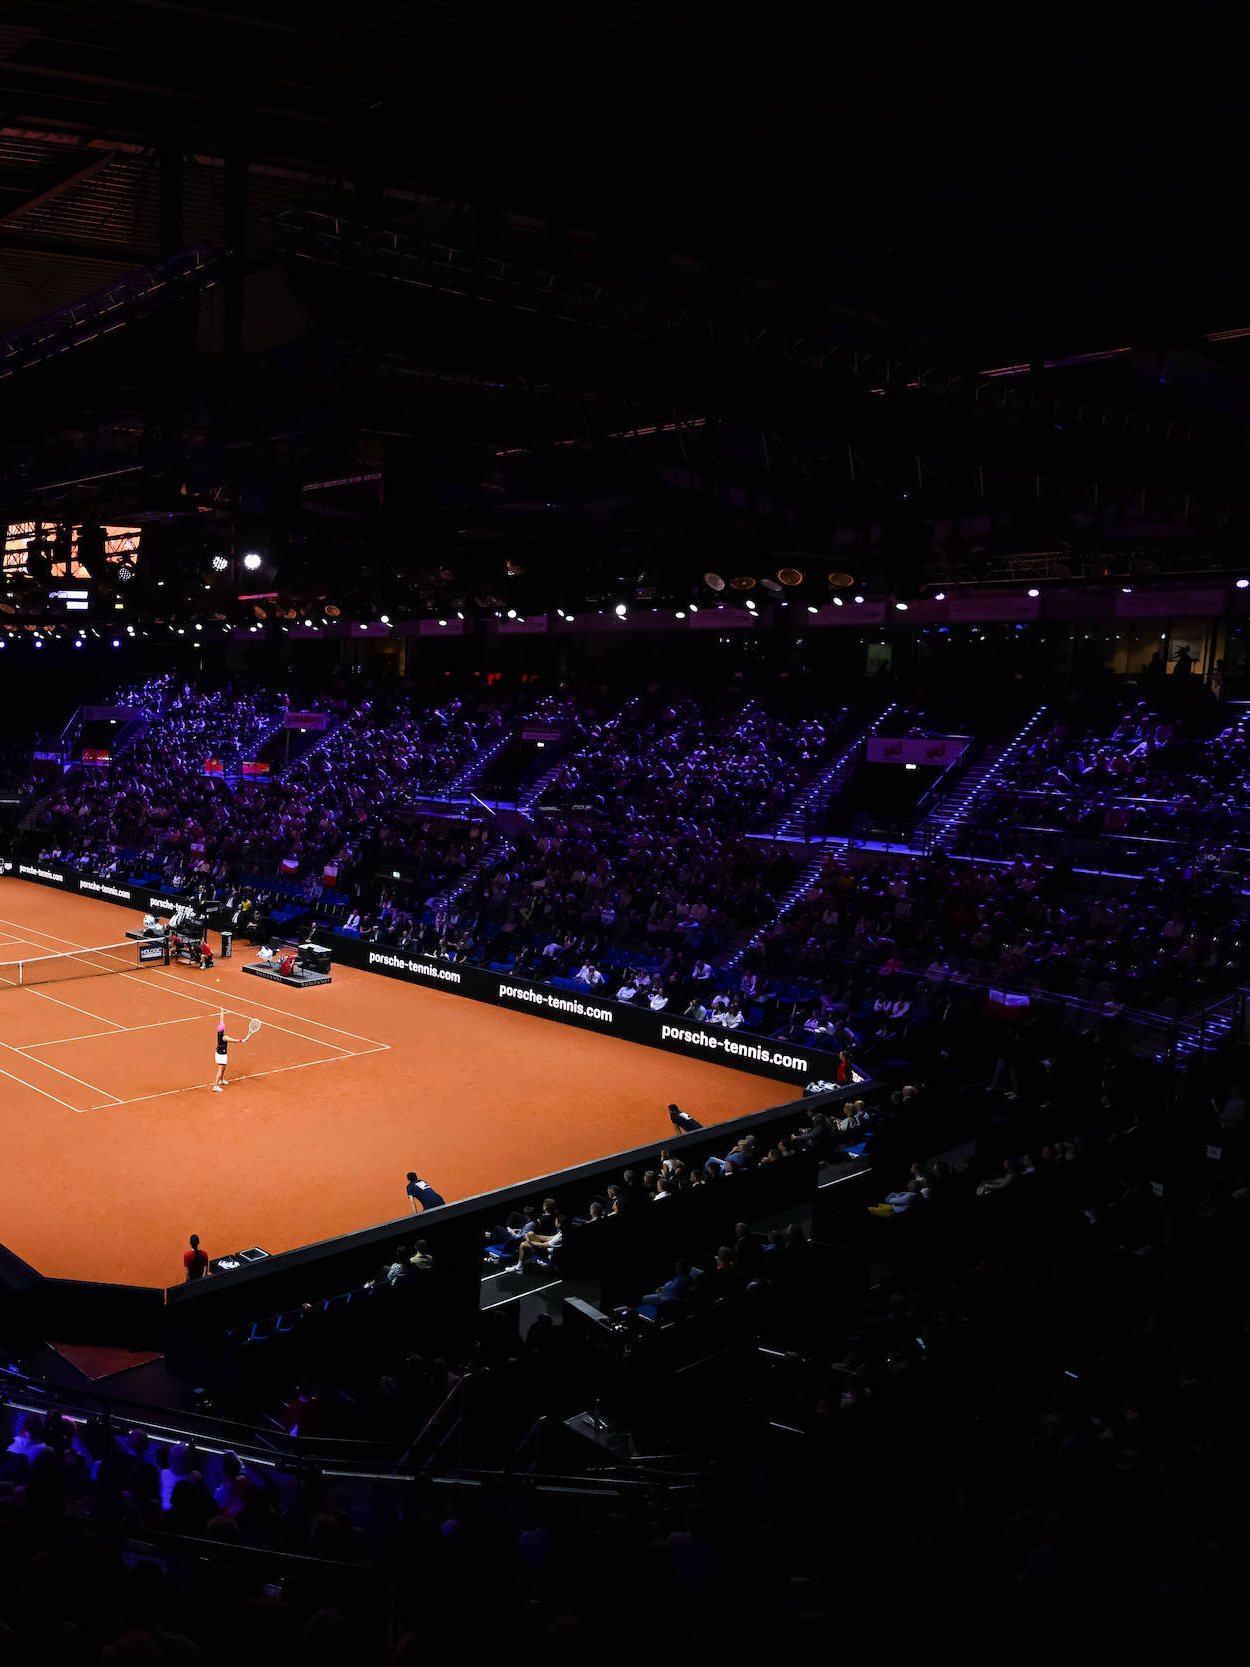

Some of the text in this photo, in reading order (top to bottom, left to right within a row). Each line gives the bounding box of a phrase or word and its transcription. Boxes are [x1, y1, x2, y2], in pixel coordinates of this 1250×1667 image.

[19, 865, 63, 882] porsche-tennis.com
[80, 880, 130, 899] porsche-tennis.com
[369, 952, 461, 983] porsche-tennis.com
[499, 984, 613, 1022] porsche-tennis.com
[662, 1024, 807, 1072] porsche-tennis.com
